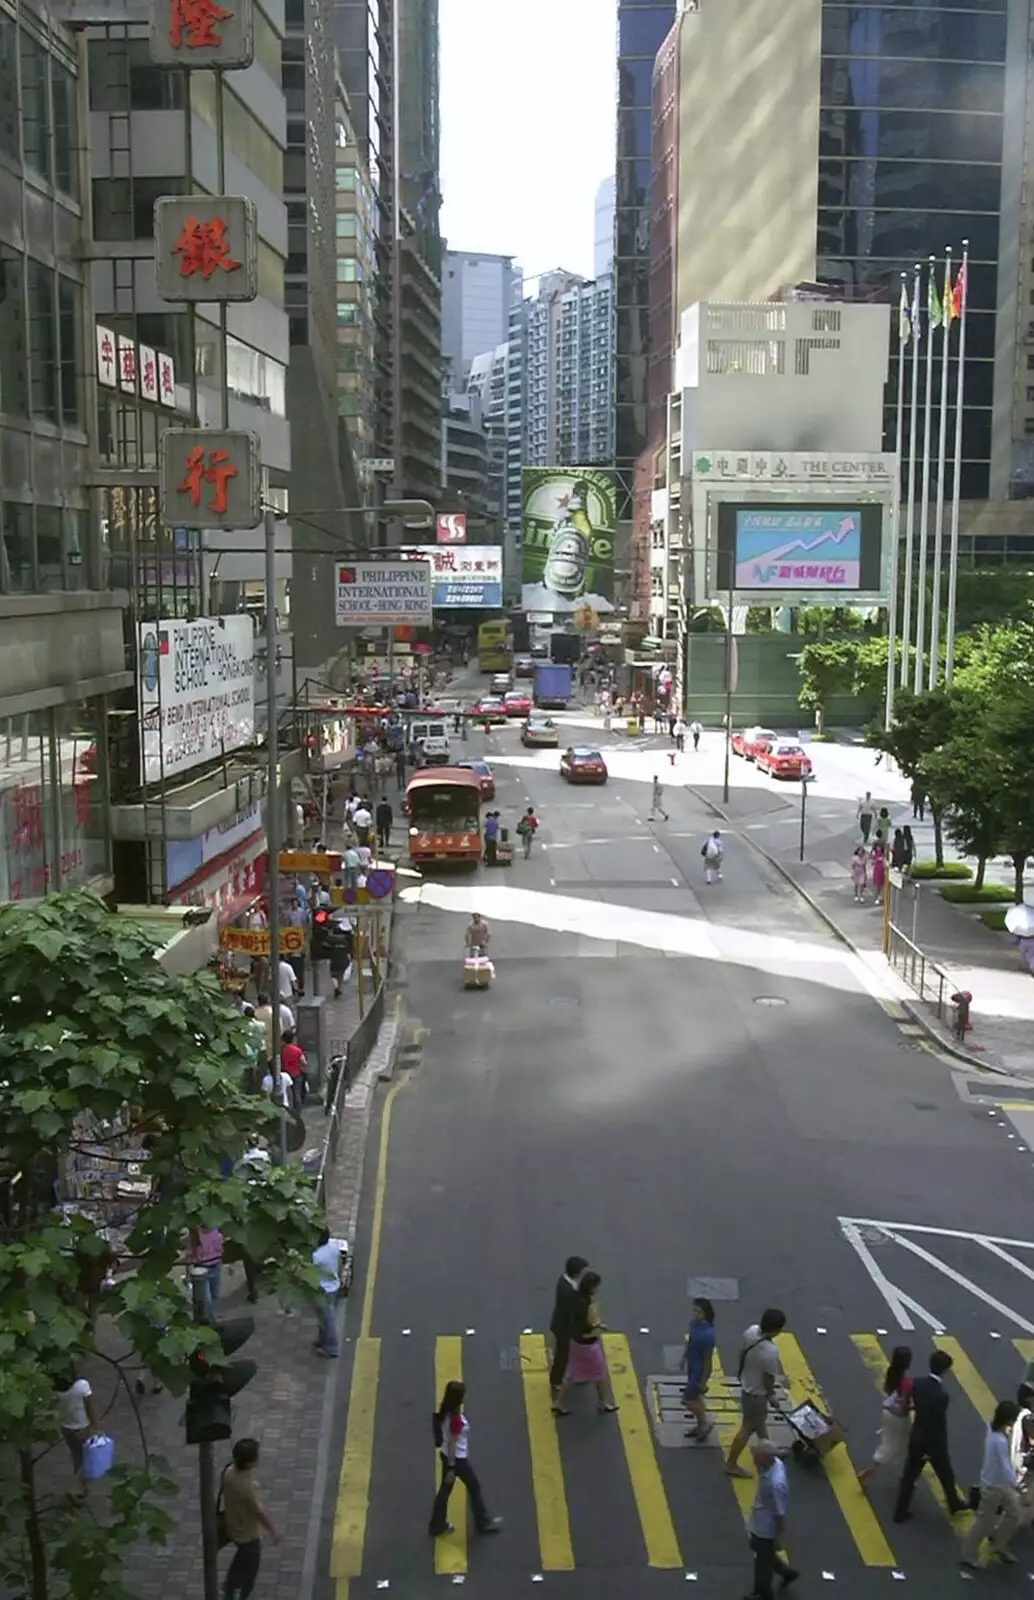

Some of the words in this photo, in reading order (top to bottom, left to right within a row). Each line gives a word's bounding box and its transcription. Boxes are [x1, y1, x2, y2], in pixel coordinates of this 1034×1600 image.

[802, 461, 828, 473] THE
[832, 460, 886, 473] CENTER
[177, 445, 239, 514] 行
[362, 570, 425, 582] PHILIPPINE
[338, 586, 427, 598] INTERNATIONAL
[339, 600, 370, 611] SCHOOL
[173, 626, 216, 649] PHILIPPINE
[174, 642, 237, 672] INTERNATIONAL
[174, 668, 209, 693] SCHOOL
